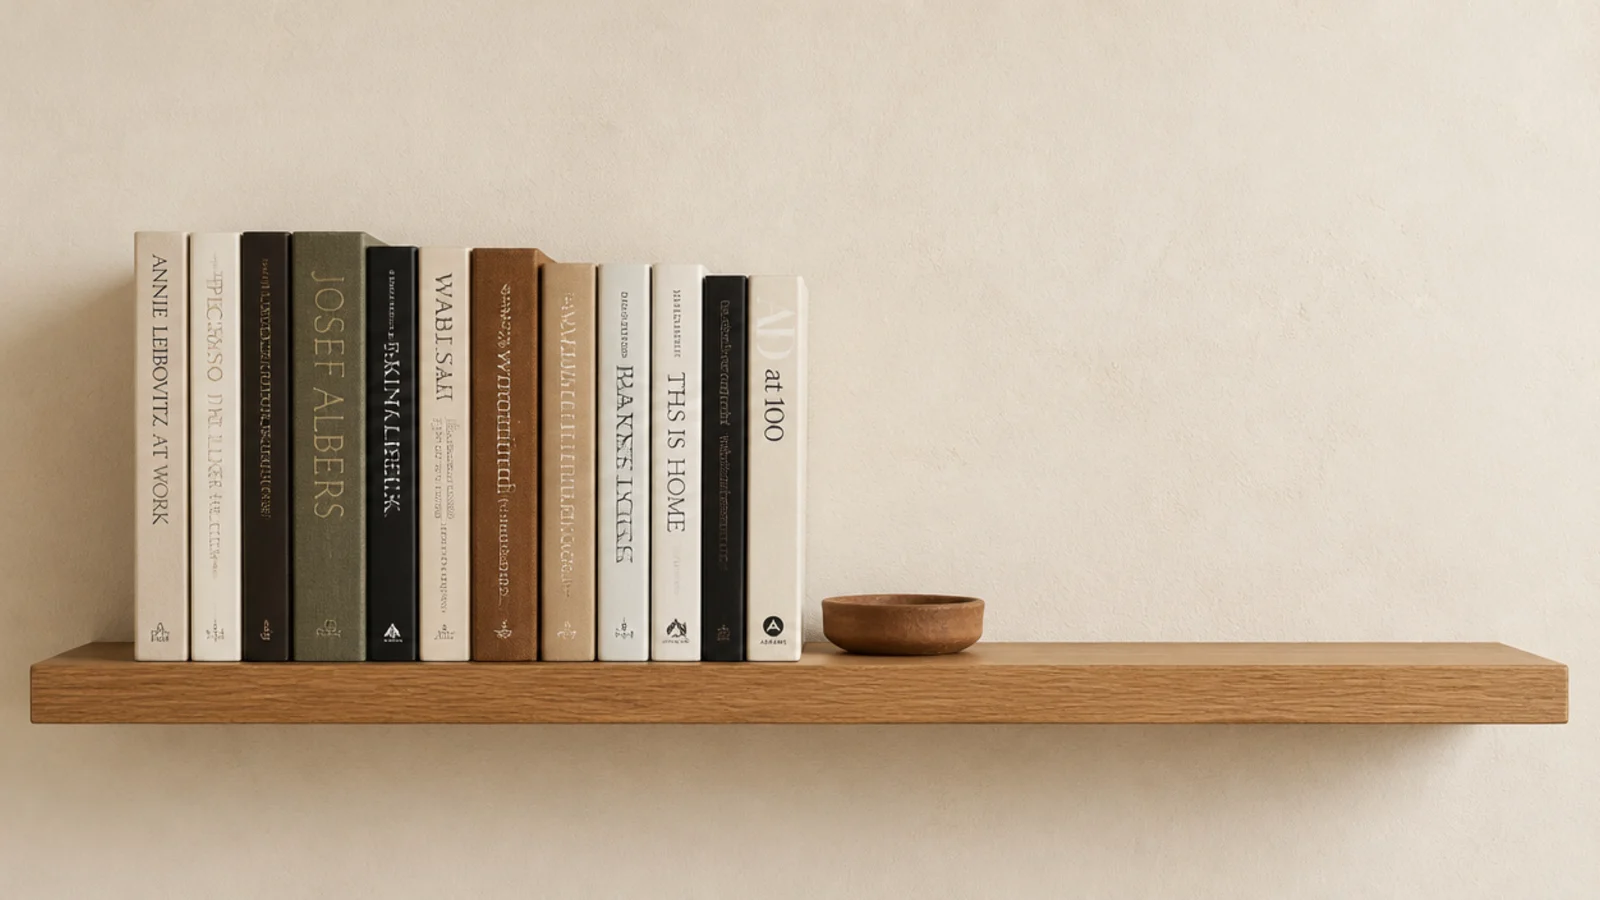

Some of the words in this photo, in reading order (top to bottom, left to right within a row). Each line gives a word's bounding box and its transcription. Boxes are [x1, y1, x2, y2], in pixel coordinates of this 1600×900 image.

[151, 254, 168, 318] ANNIE
[311, 270, 345, 379] JOSEF
[755, 295, 797, 361] AD
[151, 325, 169, 427] LEIBOVITZ
[764, 368, 782, 394] at
[151, 434, 168, 459] AT
[666, 429, 686, 449] IS
[763, 397, 785, 443] 100
[312, 387, 345, 520] ALBERS
[151, 464, 169, 526] WORK
[666, 458, 686, 533] HOME
